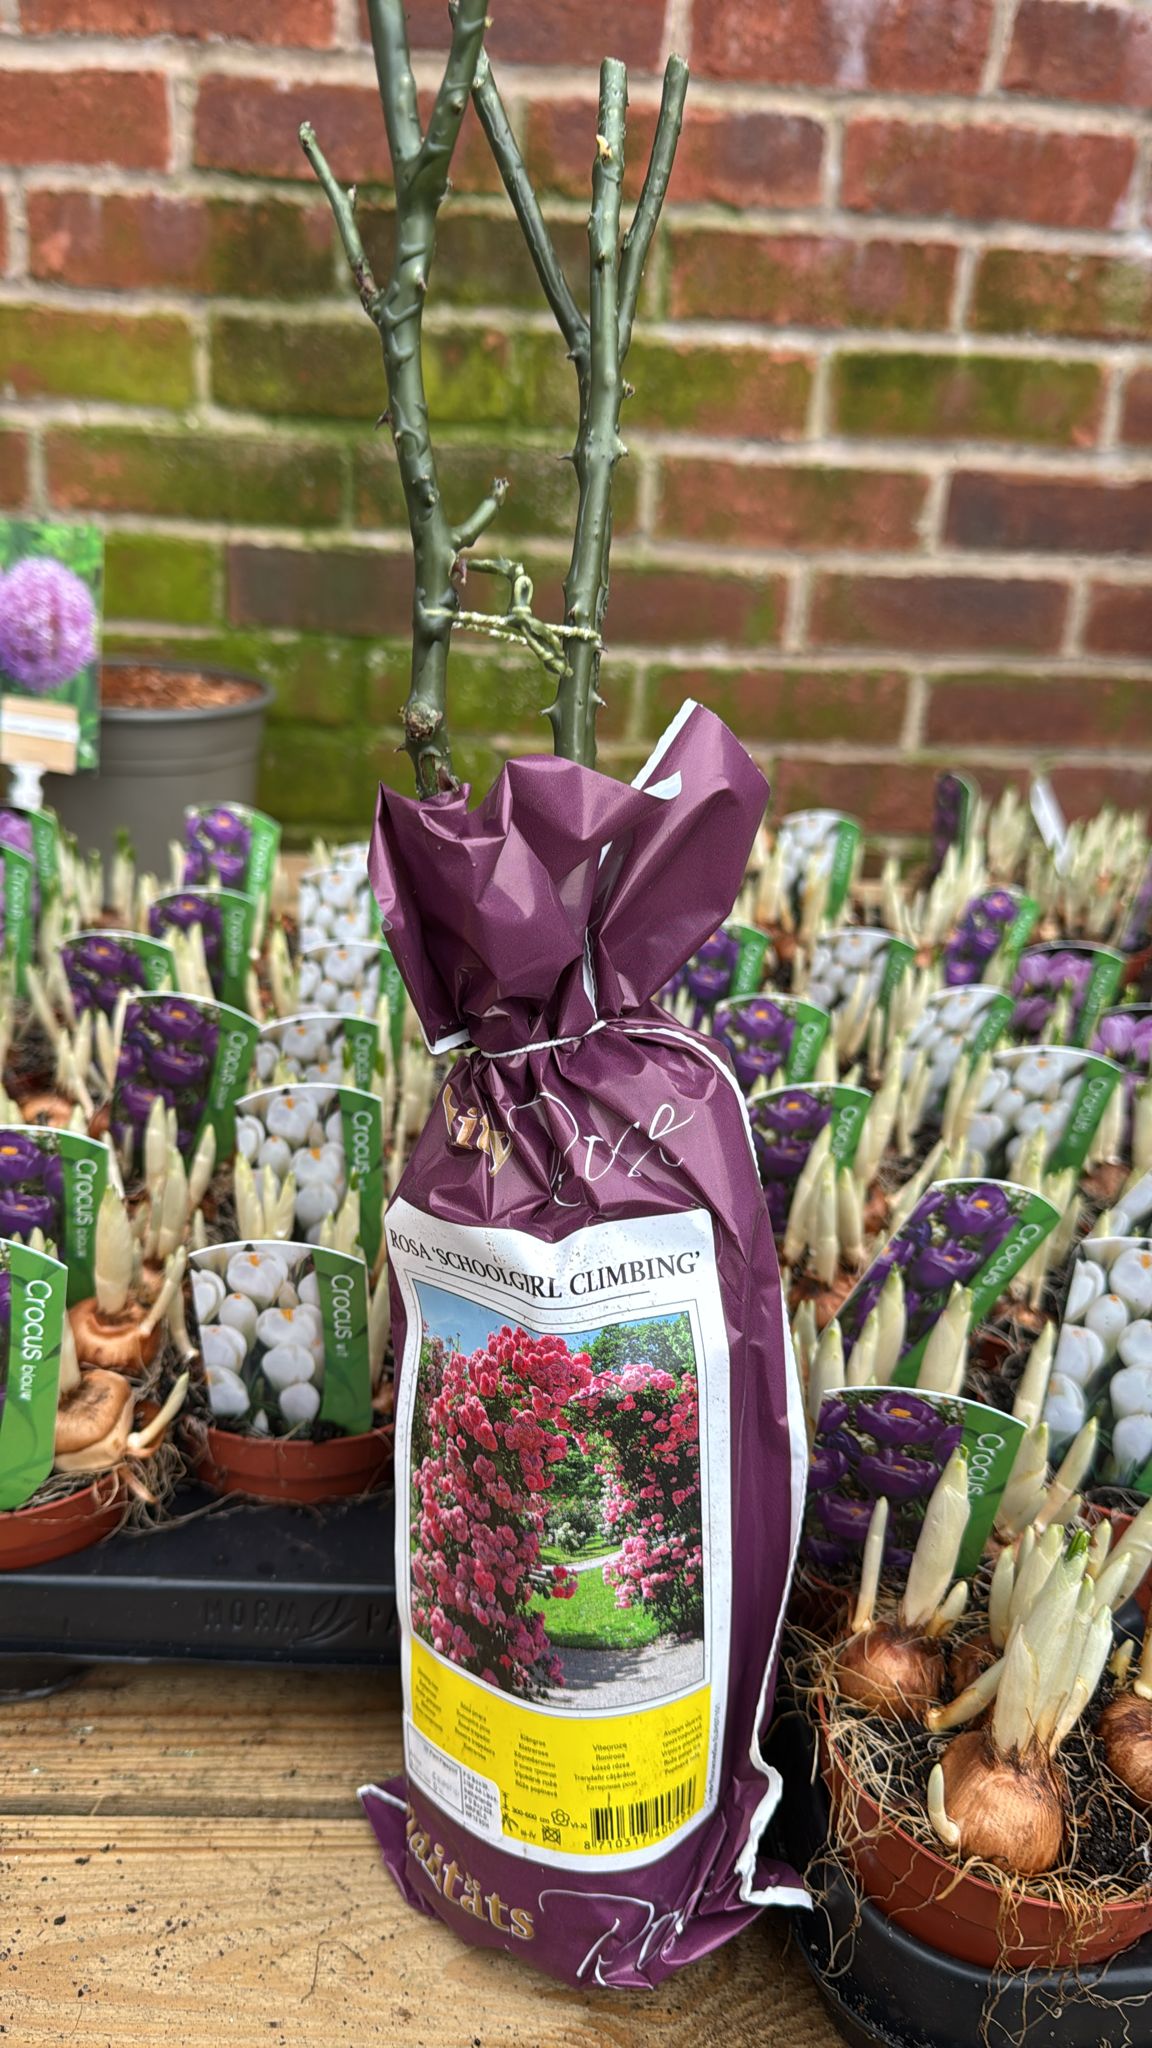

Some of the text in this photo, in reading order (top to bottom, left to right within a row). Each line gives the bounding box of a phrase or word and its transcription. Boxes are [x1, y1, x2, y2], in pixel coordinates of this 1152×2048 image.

[222, 1030, 248, 1086] Crocus
[1072, 1078, 1108, 1133] Crocus
[352, 1110, 373, 1175] Crocus
[74, 1158, 98, 1226] Crocus
[389, 1228, 433, 1262] ROSA
[982, 1223, 1042, 1286] Crocus
[331, 1274, 354, 1339] Crocus
[19, 1280, 52, 1400] Crocus blauw
[967, 1433, 1006, 1497] Crocus
